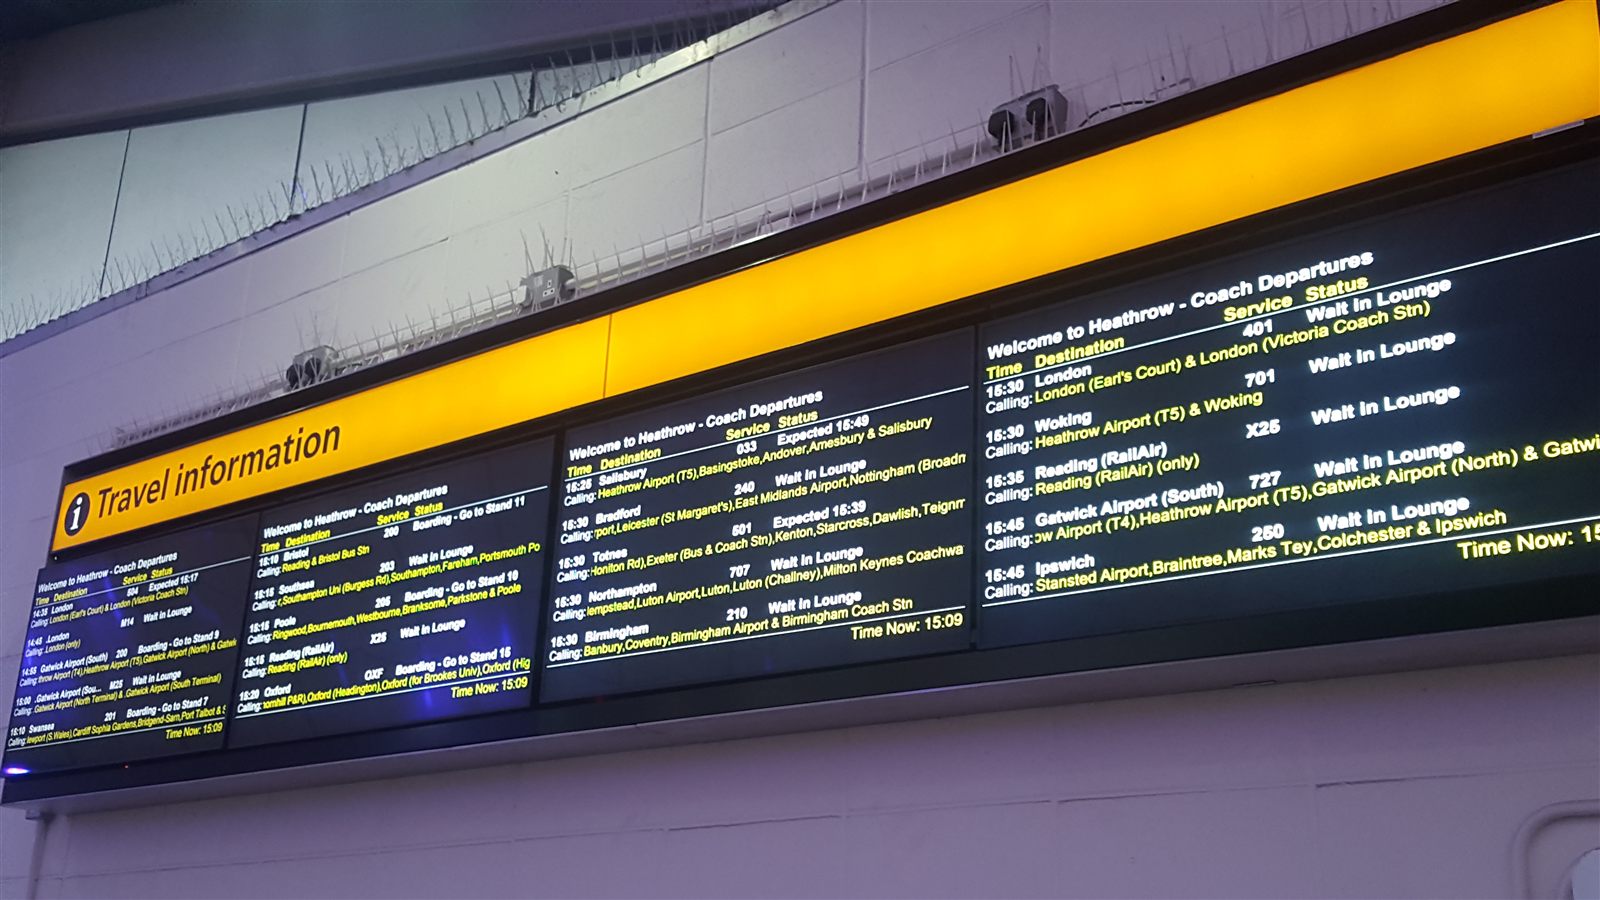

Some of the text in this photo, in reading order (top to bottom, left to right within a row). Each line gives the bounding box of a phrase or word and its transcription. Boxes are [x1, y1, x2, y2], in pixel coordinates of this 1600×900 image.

[986, 275, 1368, 380] Time Destination Service Status
[986, 377, 1024, 399] 15:30
[1035, 364, 1092, 388] London
[1242, 317, 1272, 339] 401
[1305, 300, 1347, 324] Wait
[1375, 277, 1452, 307] Lounge
[987, 251, 1374, 361] Welcome to Heathrow Coach Departures
[985, 297, 1431, 414] Calling: London (Earl's Court) & London (Victoria Coach Stn)
[985, 422, 1024, 444] 15:30
[1034, 410, 1092, 433] Woking
[1244, 367, 1275, 388] 701
[1308, 351, 1350, 374] Wait
[1378, 330, 1456, 359] Lounge
[565, 413, 869, 494] 15:25 Salisbury 033 Expected 15:49
[566, 410, 818, 478] Time Destination Service Status
[568, 390, 823, 461] Welcome to Heathrow Coach Departures
[985, 390, 1263, 459] Calling: Heathrow Airport (T5) & Woking
[985, 469, 1024, 490] 15:35
[1035, 457, 1098, 480] Reading
[1101, 439, 1167, 471] (RailAir)
[1245, 417, 1280, 439] X25
[1311, 403, 1354, 426] Wait
[1382, 384, 1461, 412] Lounge
[98, 425, 340, 518] Travel information
[561, 515, 589, 531] 15:30
[595, 503, 641, 524] Bradford
[734, 479, 755, 496] 240
[774, 470, 801, 487] Wait
[818, 458, 866, 478] Lounge
[985, 450, 1199, 505] Calling: Reading (RailAir) (only)
[985, 515, 1024, 536] 15:45
[1035, 502, 1097, 527] Gatwick
[1100, 492, 1157, 516] Airport
[1161, 479, 1224, 509] (South)
[1248, 469, 1282, 490] 727
[1313, 456, 1357, 478] Wait
[1385, 439, 1465, 466] Lounge
[260, 502, 443, 553] Time Destination Service Status
[262, 485, 448, 539] Welcome to Heathrow Coach Departures
[558, 553, 585, 570] 15:30
[591, 547, 628, 563] Totnes
[773, 505, 829, 529] Expected
[832, 498, 866, 517] 15:39
[985, 563, 1024, 583] 15:45
[1035, 551, 1095, 579] Ipswich
[1251, 521, 1284, 542] 250
[1317, 510, 1361, 532] Wait
[1389, 495, 1470, 520] Lounge
[1456, 539, 1510, 560] Time
[1515, 530, 1573, 552] Now:
[37, 552, 178, 593] Welcome to Heathrow Coach Departures
[256, 545, 370, 578] Calling: Reading & Bristol Bus Stn
[554, 592, 582, 608] 15:30
[588, 581, 657, 602] Northampton
[728, 563, 750, 578] 707
[770, 554, 797, 571] Wait
[814, 545, 863, 564] Lounge
[548, 647, 582, 661] Calling:
[731, 618, 767, 635] Airport
[769, 615, 778, 629] &
[780, 607, 848, 627] Birmingham
[850, 598, 889, 617] Coach
[891, 597, 913, 611] Stn
[550, 632, 578, 648] 15:30
[584, 623, 649, 642] Birmingham
[726, 605, 748, 621] 210
[767, 598, 795, 614] Wait
[812, 590, 861, 608] Lounge
[850, 611, 963, 641] Time Now: 15:09
[449, 676, 528, 699] Time Now: 15:09
[164, 721, 223, 739] Time Now: 15:09
